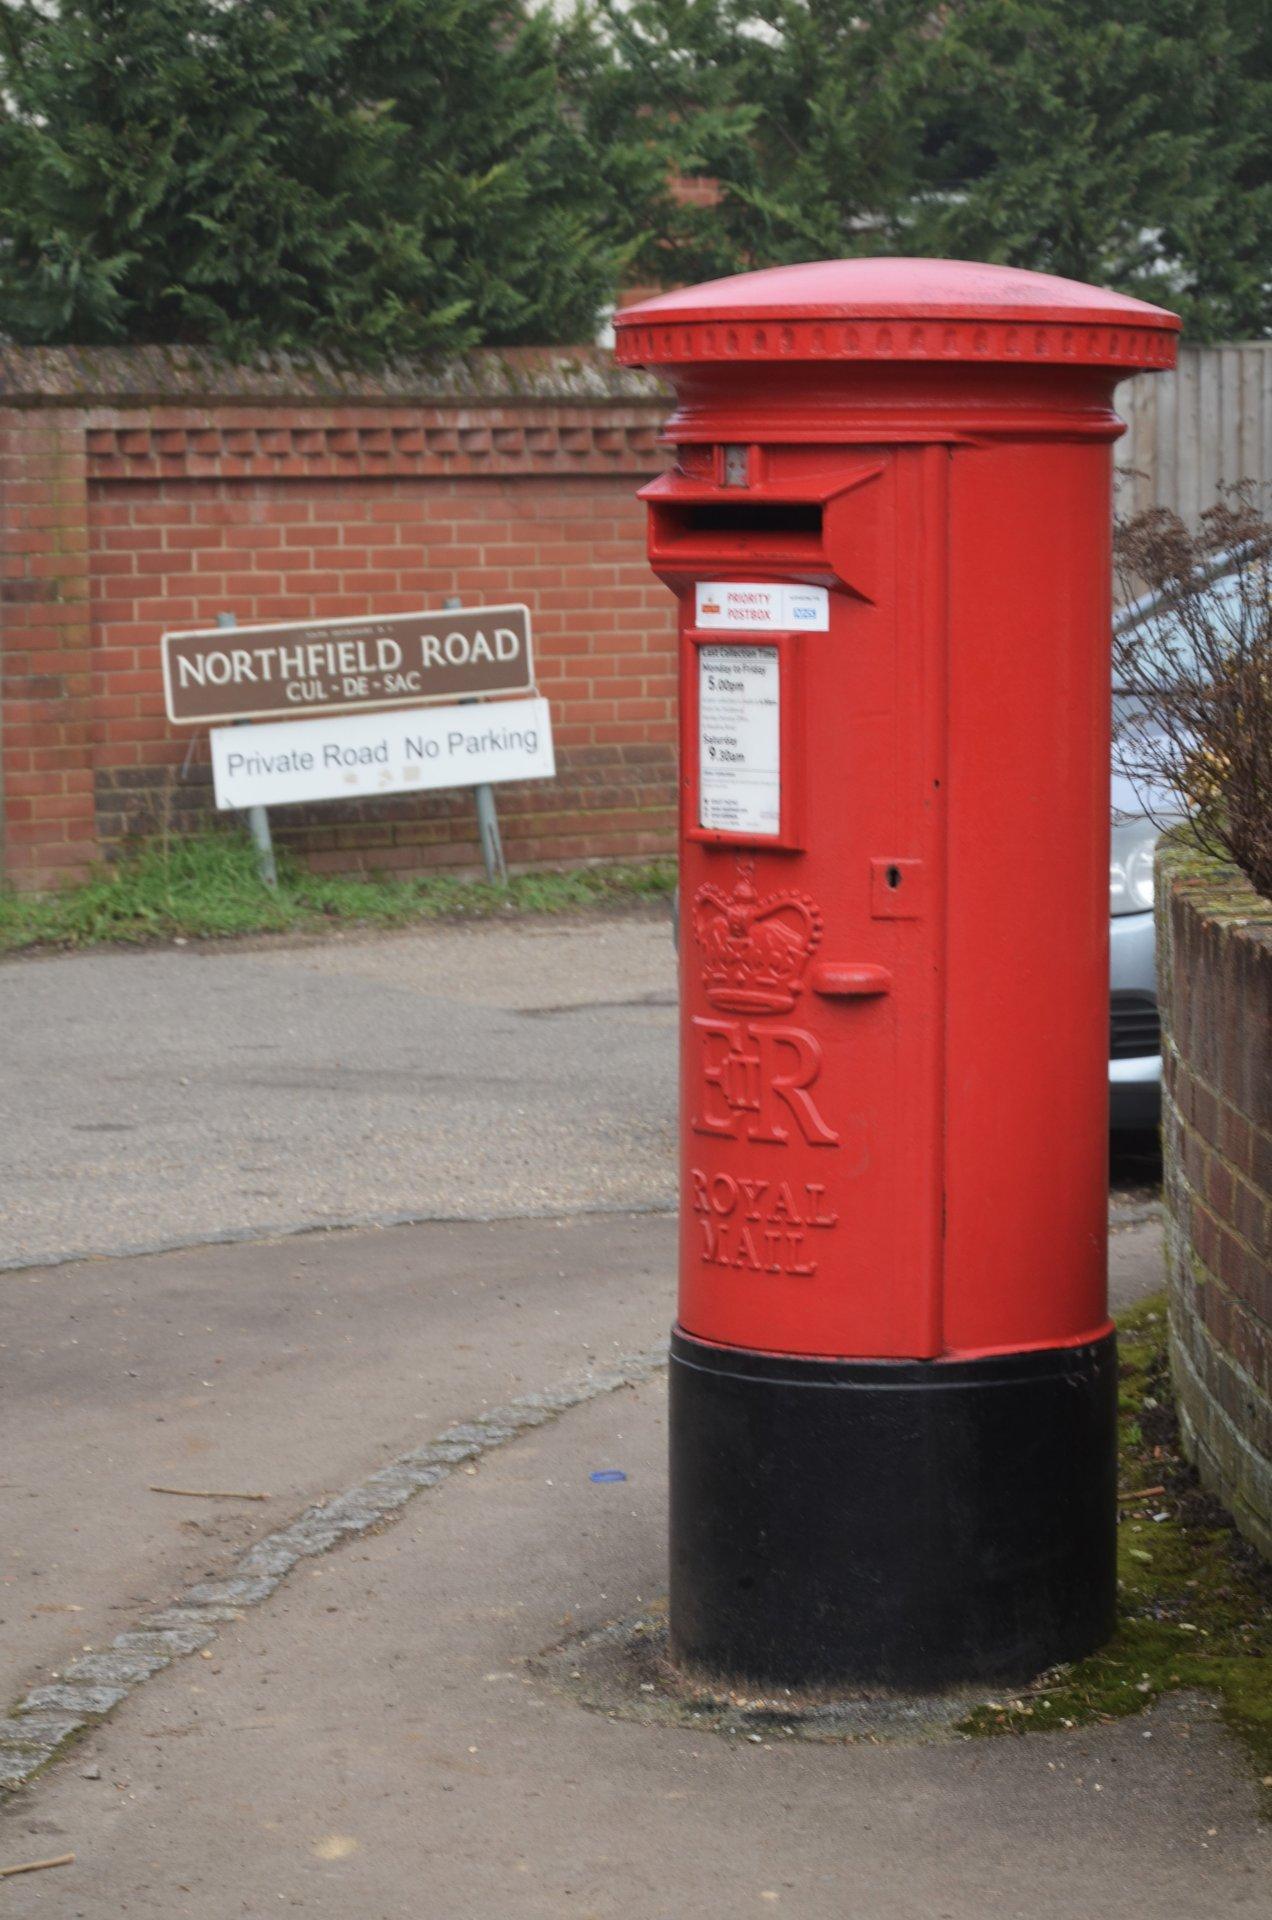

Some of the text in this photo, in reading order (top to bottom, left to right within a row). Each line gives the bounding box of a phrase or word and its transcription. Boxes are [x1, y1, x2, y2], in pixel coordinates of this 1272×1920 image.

[727, 591, 771, 604] PRIORITY
[727, 607, 772, 620] POSTBOX
[176, 628, 520, 689] NORTHFIELD ROAD
[702, 663, 731, 675] Monday
[742, 663, 766, 677] Friday
[708, 675, 744, 693] 5.00pm
[702, 733, 737, 747] Saturday
[227, 728, 539, 778] Private Road No Parking
[708, 746, 745, 762] 9.30am
[690, 1167, 839, 1228] ROYAL
[700, 1218, 818, 1277] MAIL
